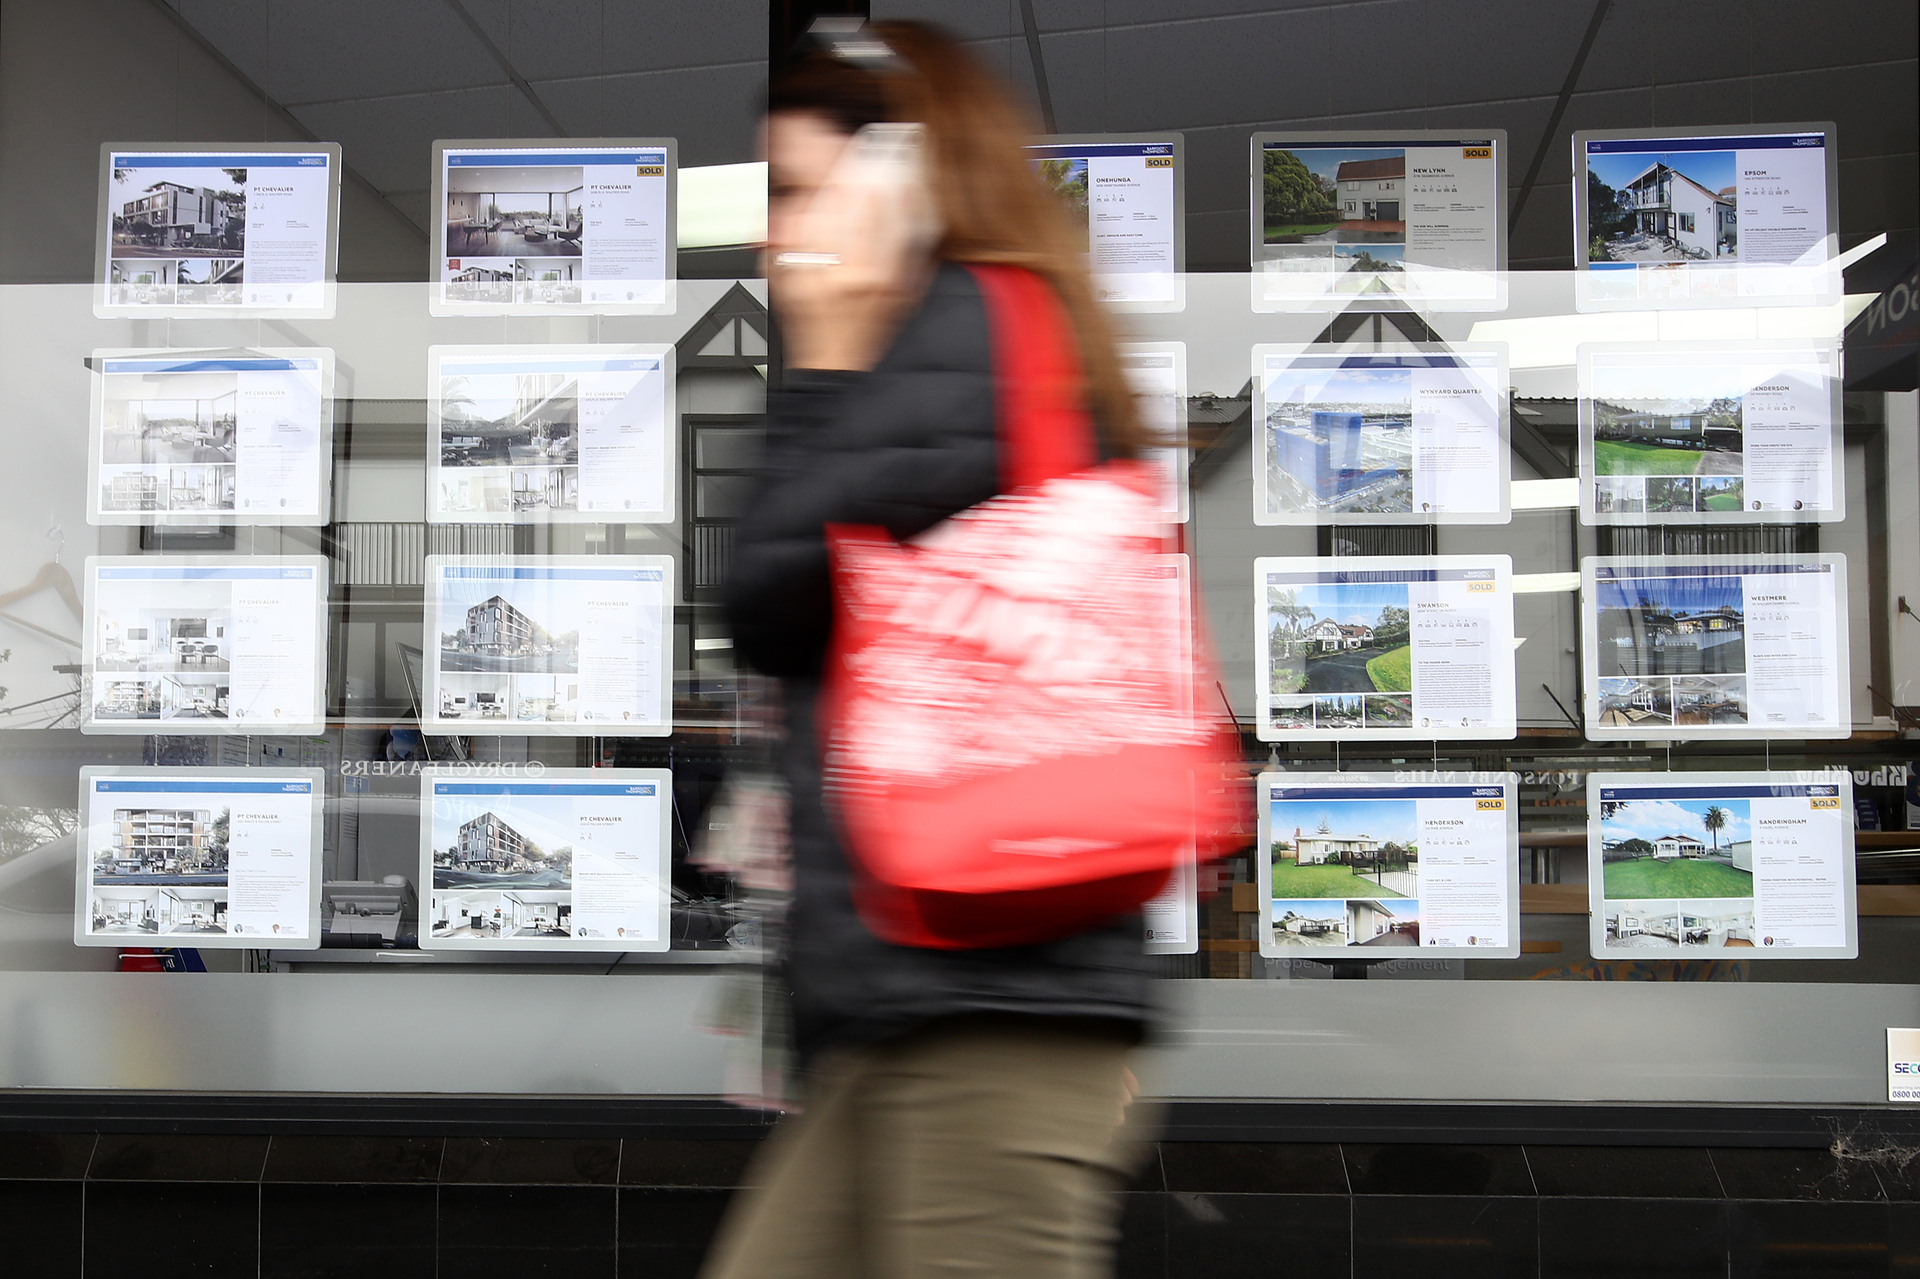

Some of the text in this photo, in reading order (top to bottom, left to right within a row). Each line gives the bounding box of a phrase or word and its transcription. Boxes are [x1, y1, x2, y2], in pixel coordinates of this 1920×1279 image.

[1469, 583, 1492, 591] SOLD
[1812, 799, 1837, 808] SOLD
[1892, 1090, 1911, 1098] 0800
